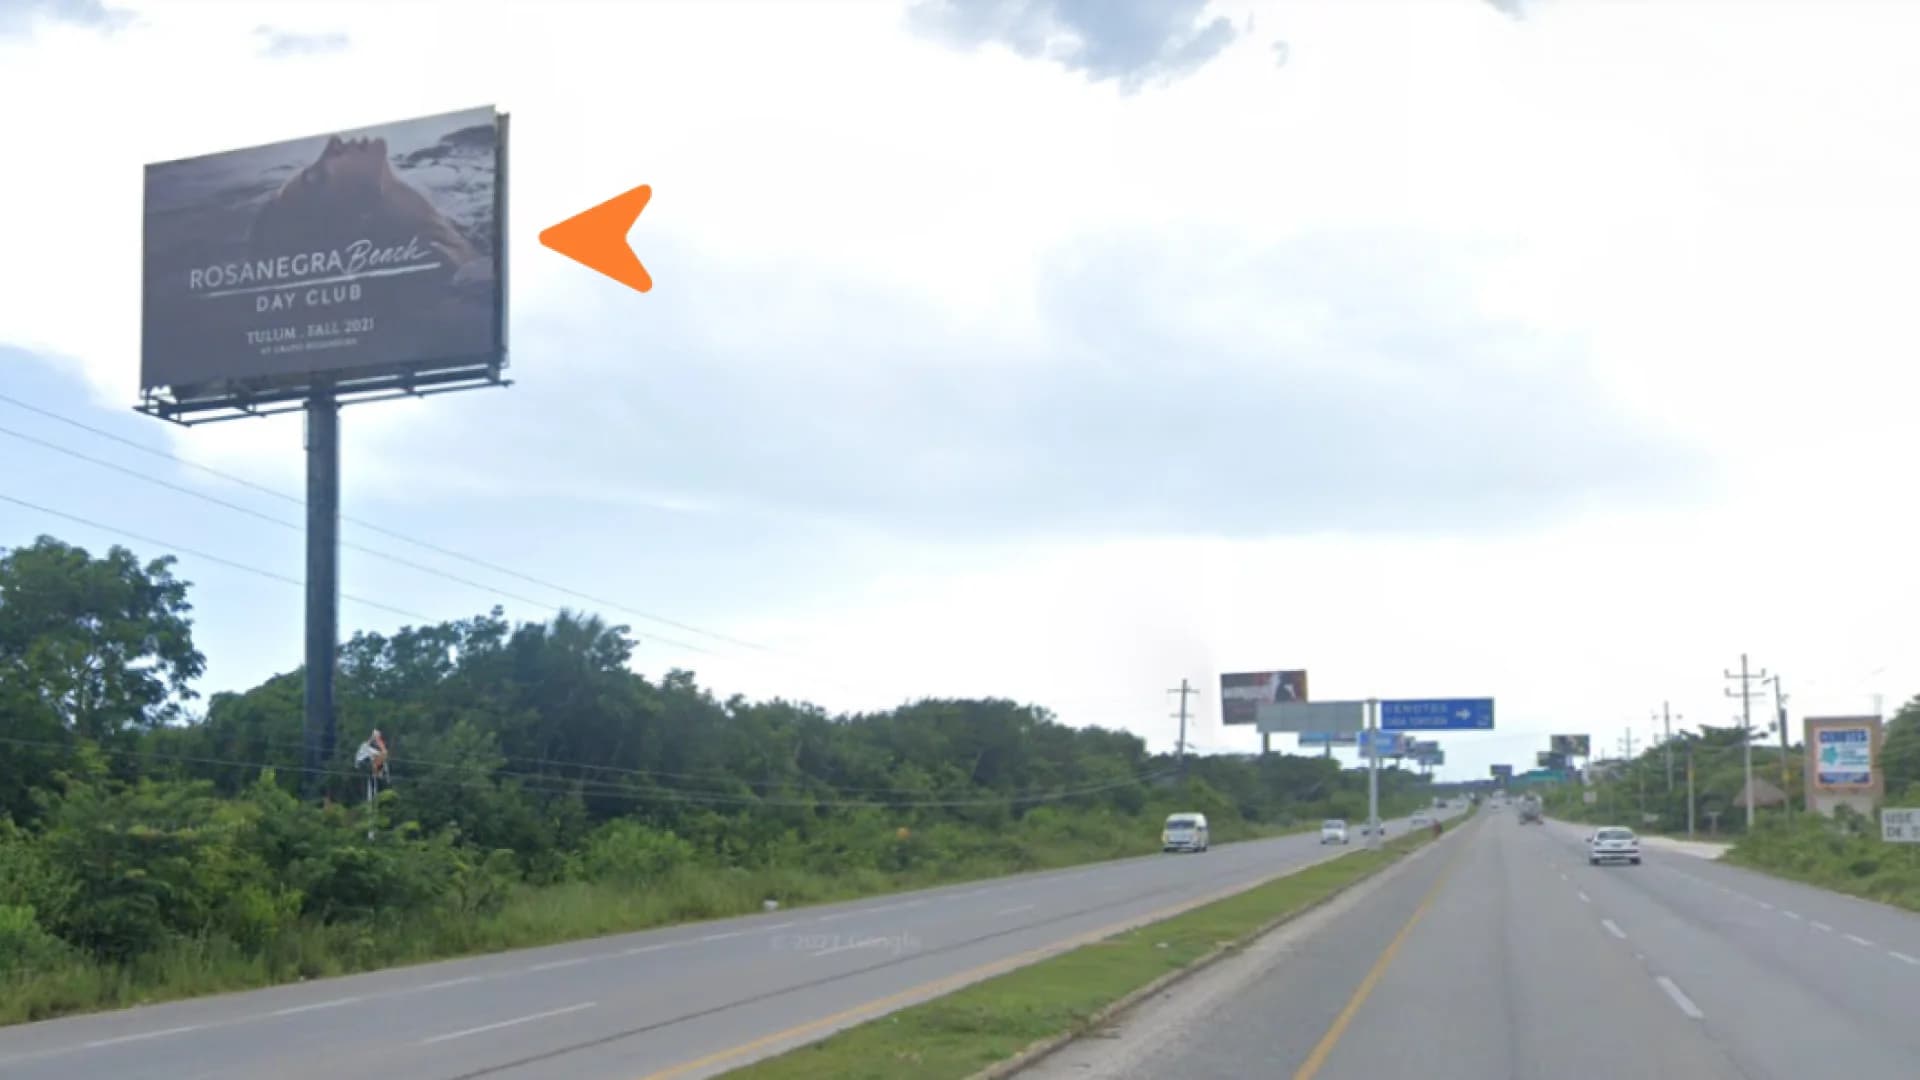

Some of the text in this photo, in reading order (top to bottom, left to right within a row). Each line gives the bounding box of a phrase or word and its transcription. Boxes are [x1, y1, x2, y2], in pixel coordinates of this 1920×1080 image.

[190, 237, 432, 289] ROSANEGRA Beach
[256, 284, 362, 312] DAY CLUB
[246, 327, 296, 345] TULUM
[344, 317, 375, 334] 2021
